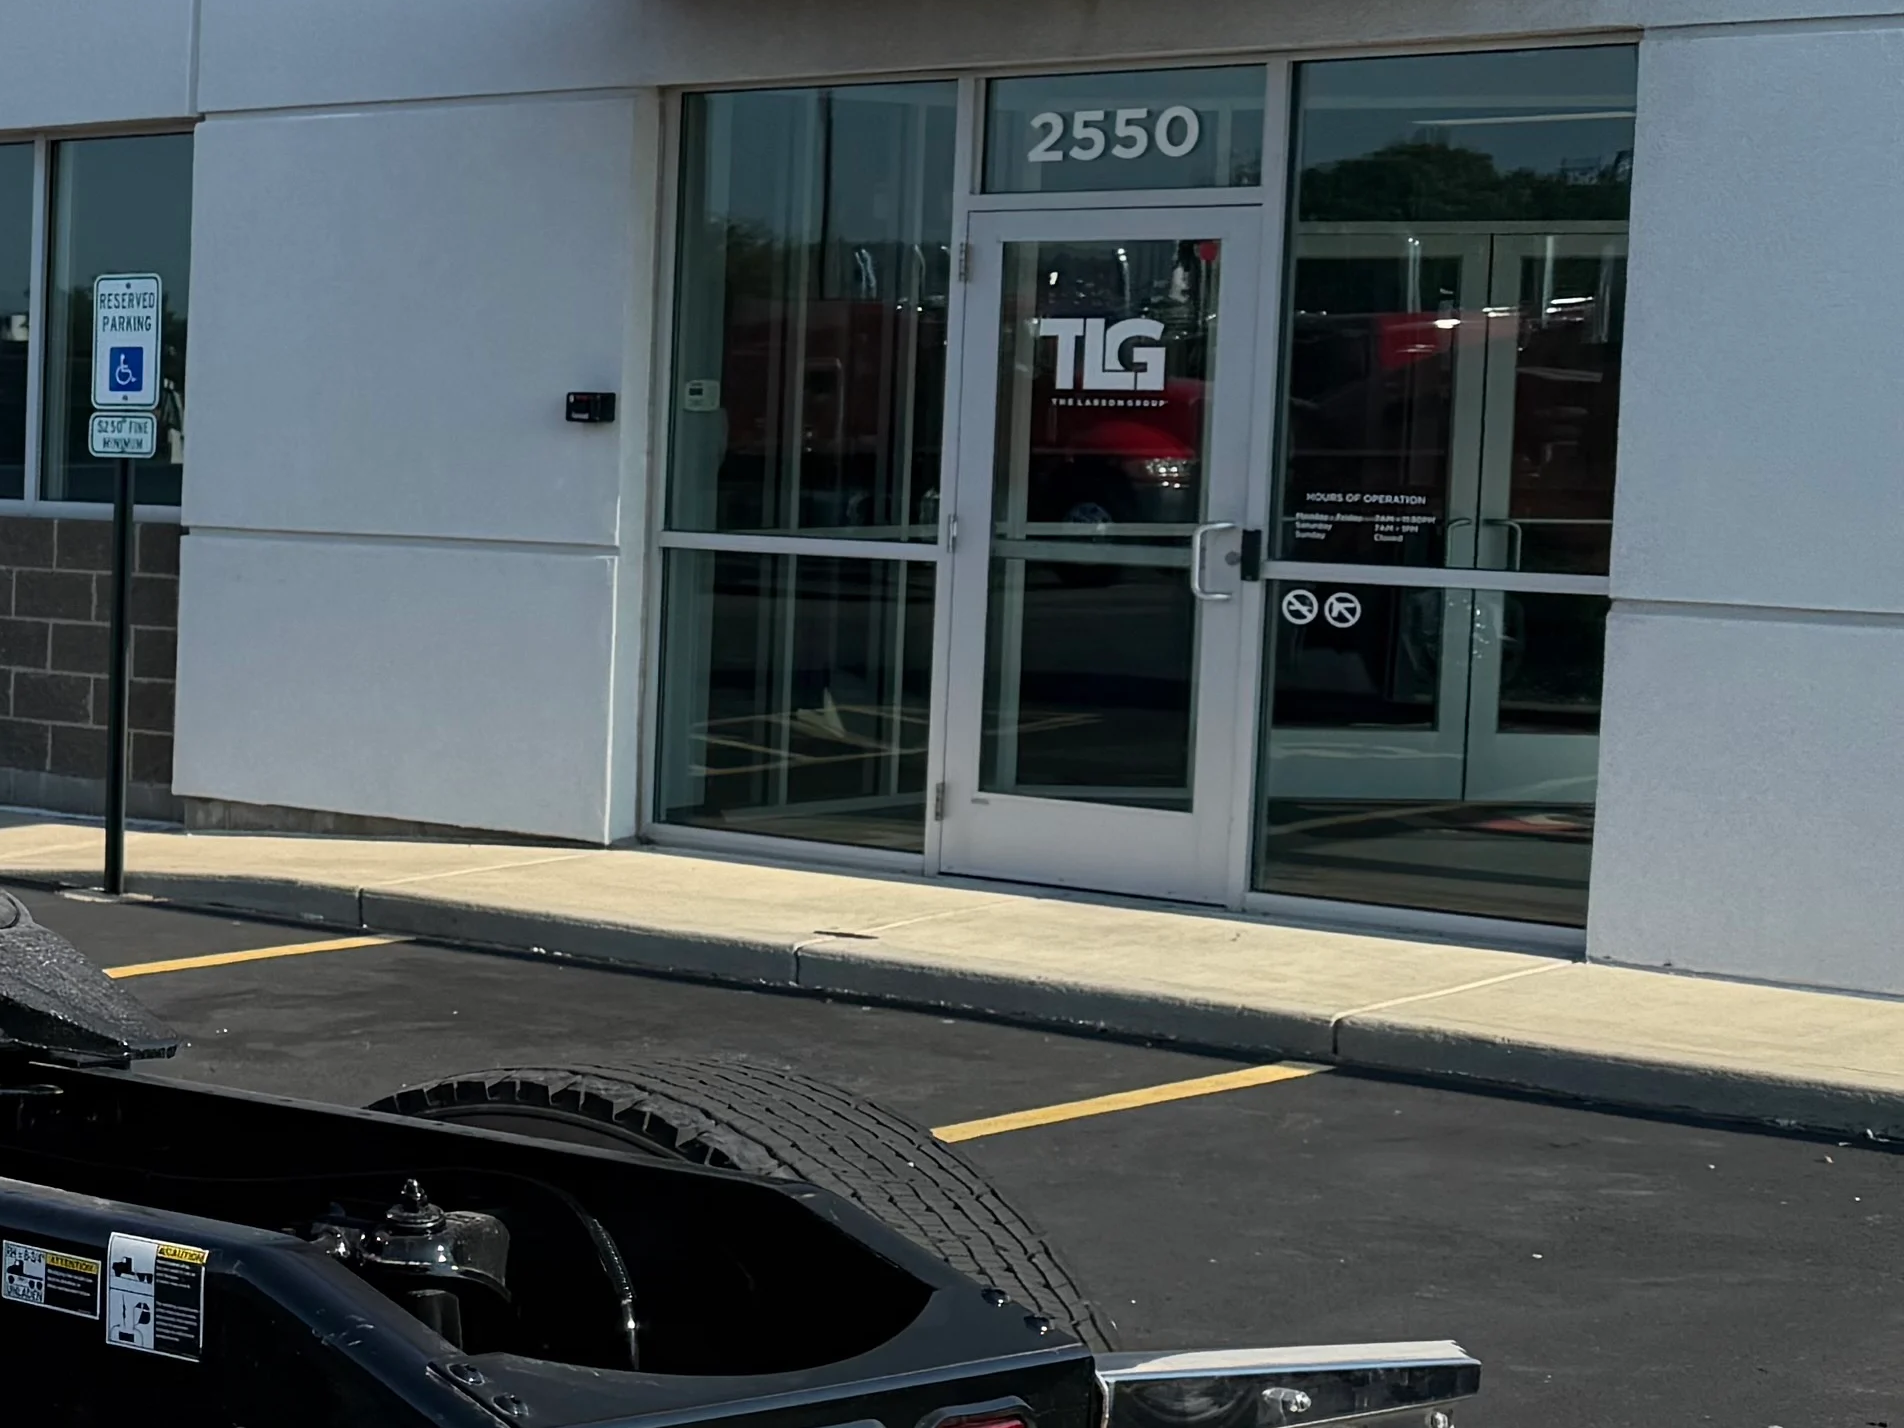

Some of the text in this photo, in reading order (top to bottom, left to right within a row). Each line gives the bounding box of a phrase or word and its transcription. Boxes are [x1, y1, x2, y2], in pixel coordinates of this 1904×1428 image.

[1027, 105, 1200, 163] 2550
[99, 292, 155, 309] RESERVED
[103, 315, 152, 332] PARKING
[1039, 317, 1166, 391] TLG
[1306, 492, 1426, 505] HOURS OF OPERATION
